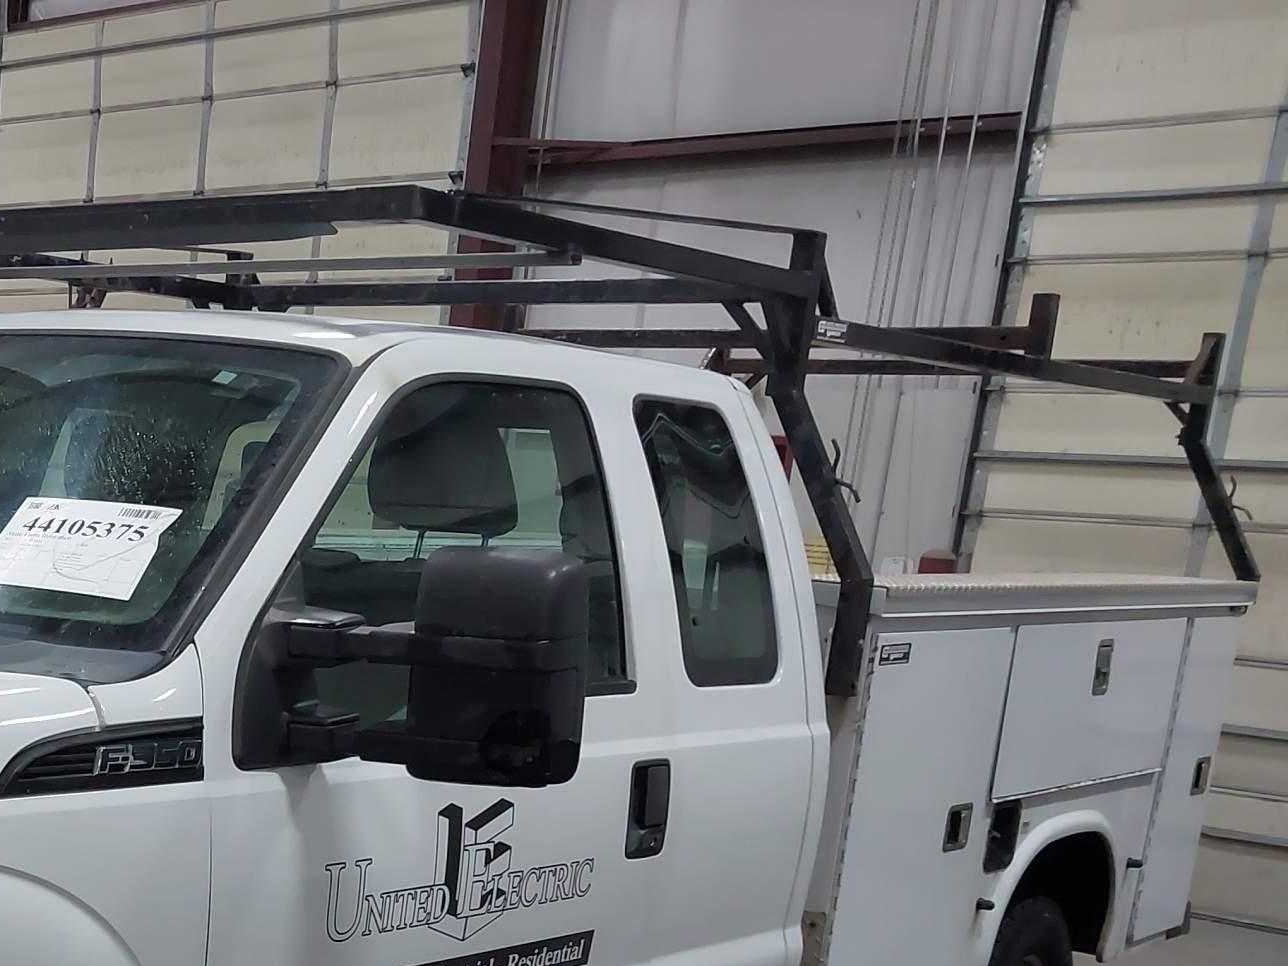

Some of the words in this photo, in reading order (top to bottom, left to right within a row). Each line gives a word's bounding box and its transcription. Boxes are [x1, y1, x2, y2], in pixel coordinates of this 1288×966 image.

[22, 516, 150, 542] 44105375
[325, 858, 450, 942] UNITED
[456, 842, 594, 919] ELECTRIC
